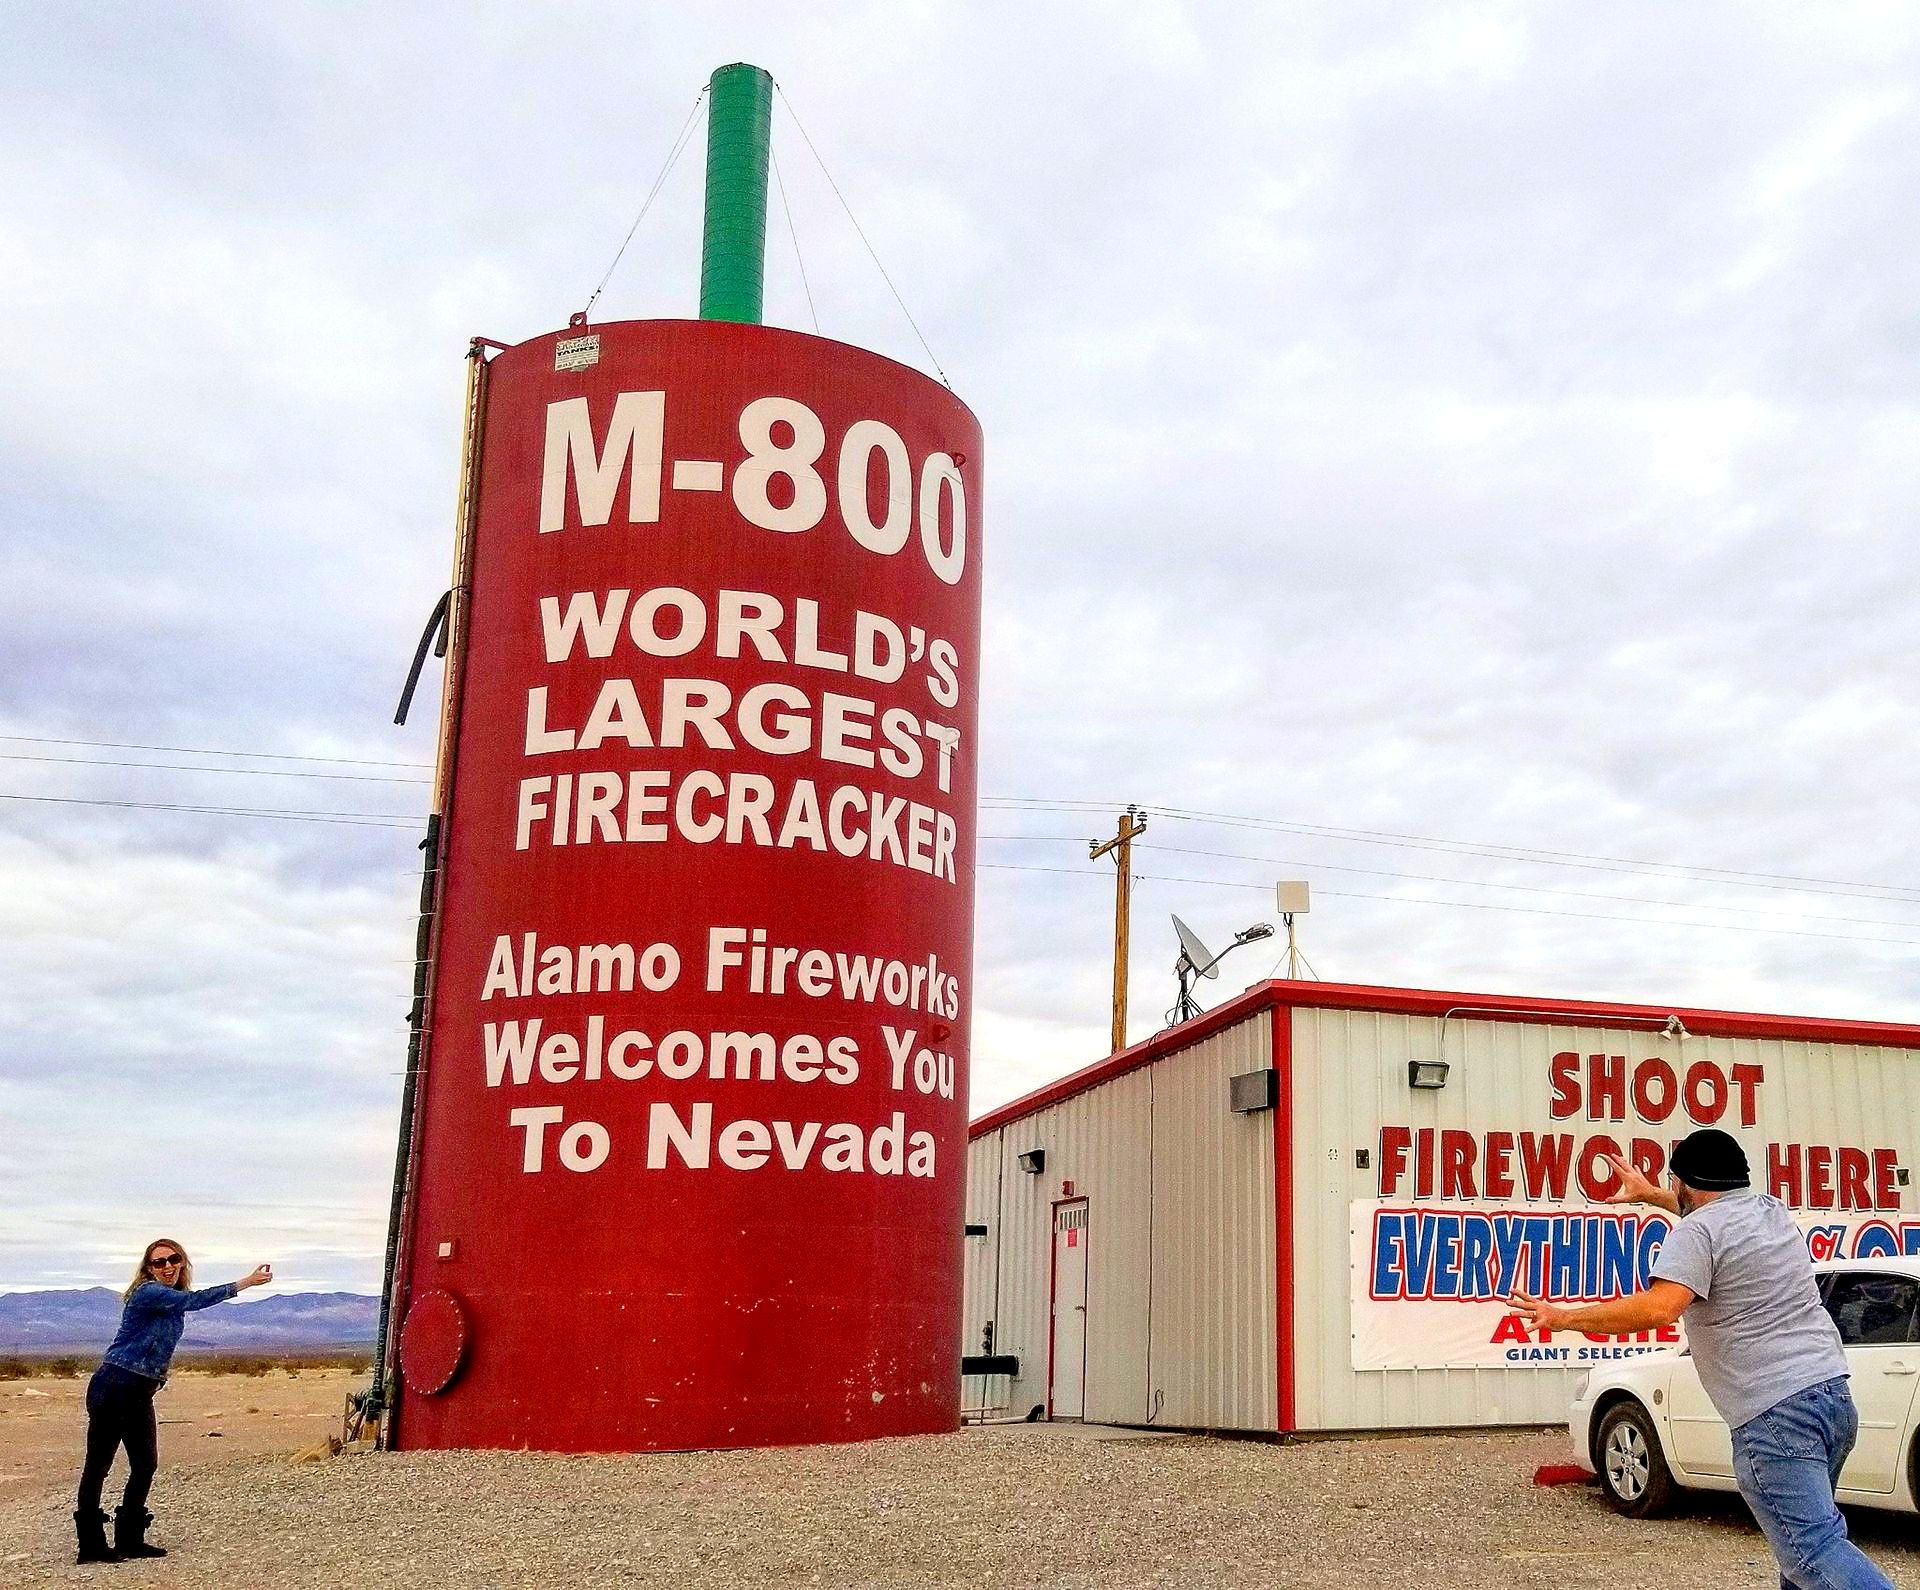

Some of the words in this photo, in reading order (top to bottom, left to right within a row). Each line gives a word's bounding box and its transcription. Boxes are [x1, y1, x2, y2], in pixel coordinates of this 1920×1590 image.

[540, 390, 967, 585] M-800
[540, 587, 959, 708] WORLD'S
[525, 679, 959, 794] LARGEST
[516, 770, 957, 885] FIRECRACKER
[481, 932, 681, 1001] Alamo
[706, 927, 959, 1021] Fireworks
[483, 1015, 860, 1087] Welcomes
[880, 1025, 955, 1101] You
[1549, 1051, 1765, 1129] SHOOT
[510, 1105, 610, 1173] To
[646, 1102, 936, 1178] Nevada
[1378, 1126, 1684, 1204] FIREWOR
[1766, 1143, 1902, 1212] HERE
[1506, 1347, 1570, 1360] GIANT
